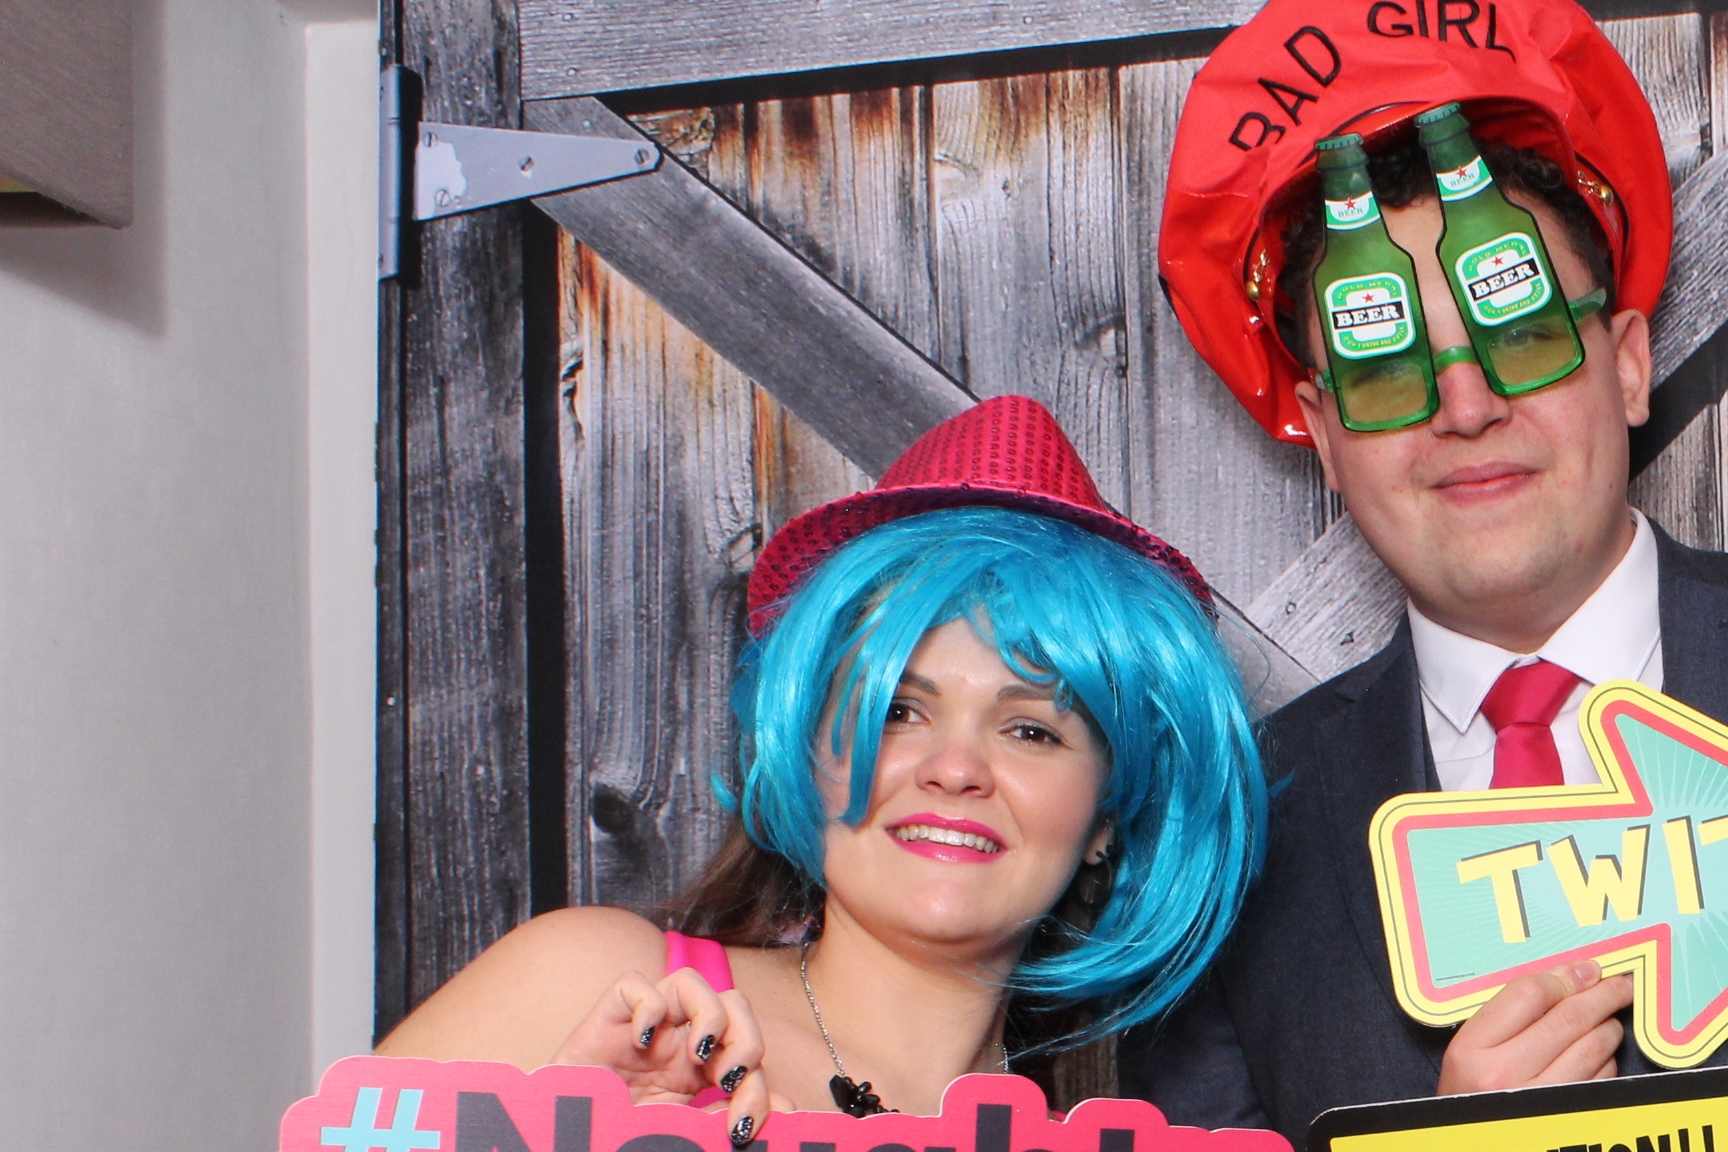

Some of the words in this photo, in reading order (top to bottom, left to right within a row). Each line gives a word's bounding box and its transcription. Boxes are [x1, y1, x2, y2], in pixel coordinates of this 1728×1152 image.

[1229, 26, 1342, 152] BAD
[1367, 0, 1517, 64] GIRL
[1450, 173, 1475, 188] BEER
[1338, 207, 1364, 218] BEER
[1472, 263, 1535, 299] BEER
[1335, 304, 1400, 328] BEER
